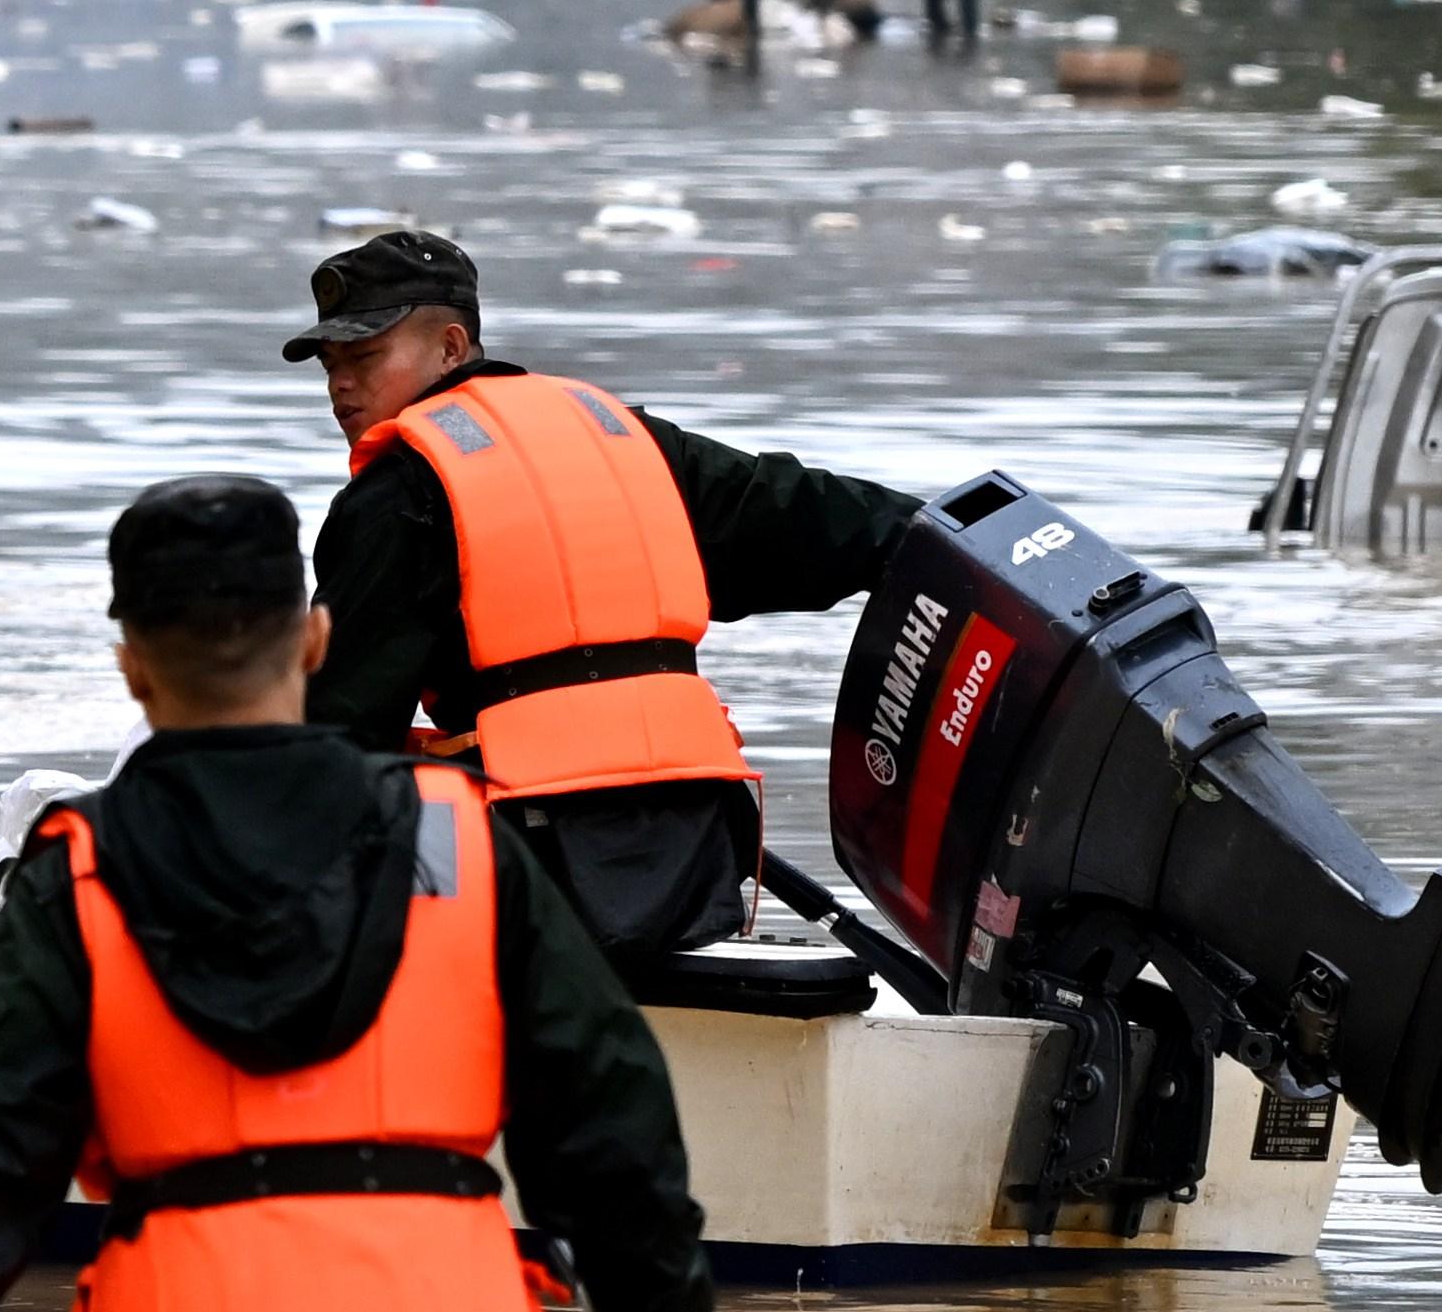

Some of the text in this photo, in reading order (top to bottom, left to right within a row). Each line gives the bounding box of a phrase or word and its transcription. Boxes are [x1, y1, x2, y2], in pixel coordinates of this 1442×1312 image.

[1011, 522, 1075, 566] 48
[871, 592, 949, 745] YAMAHA
[939, 650, 992, 747] Enduro
